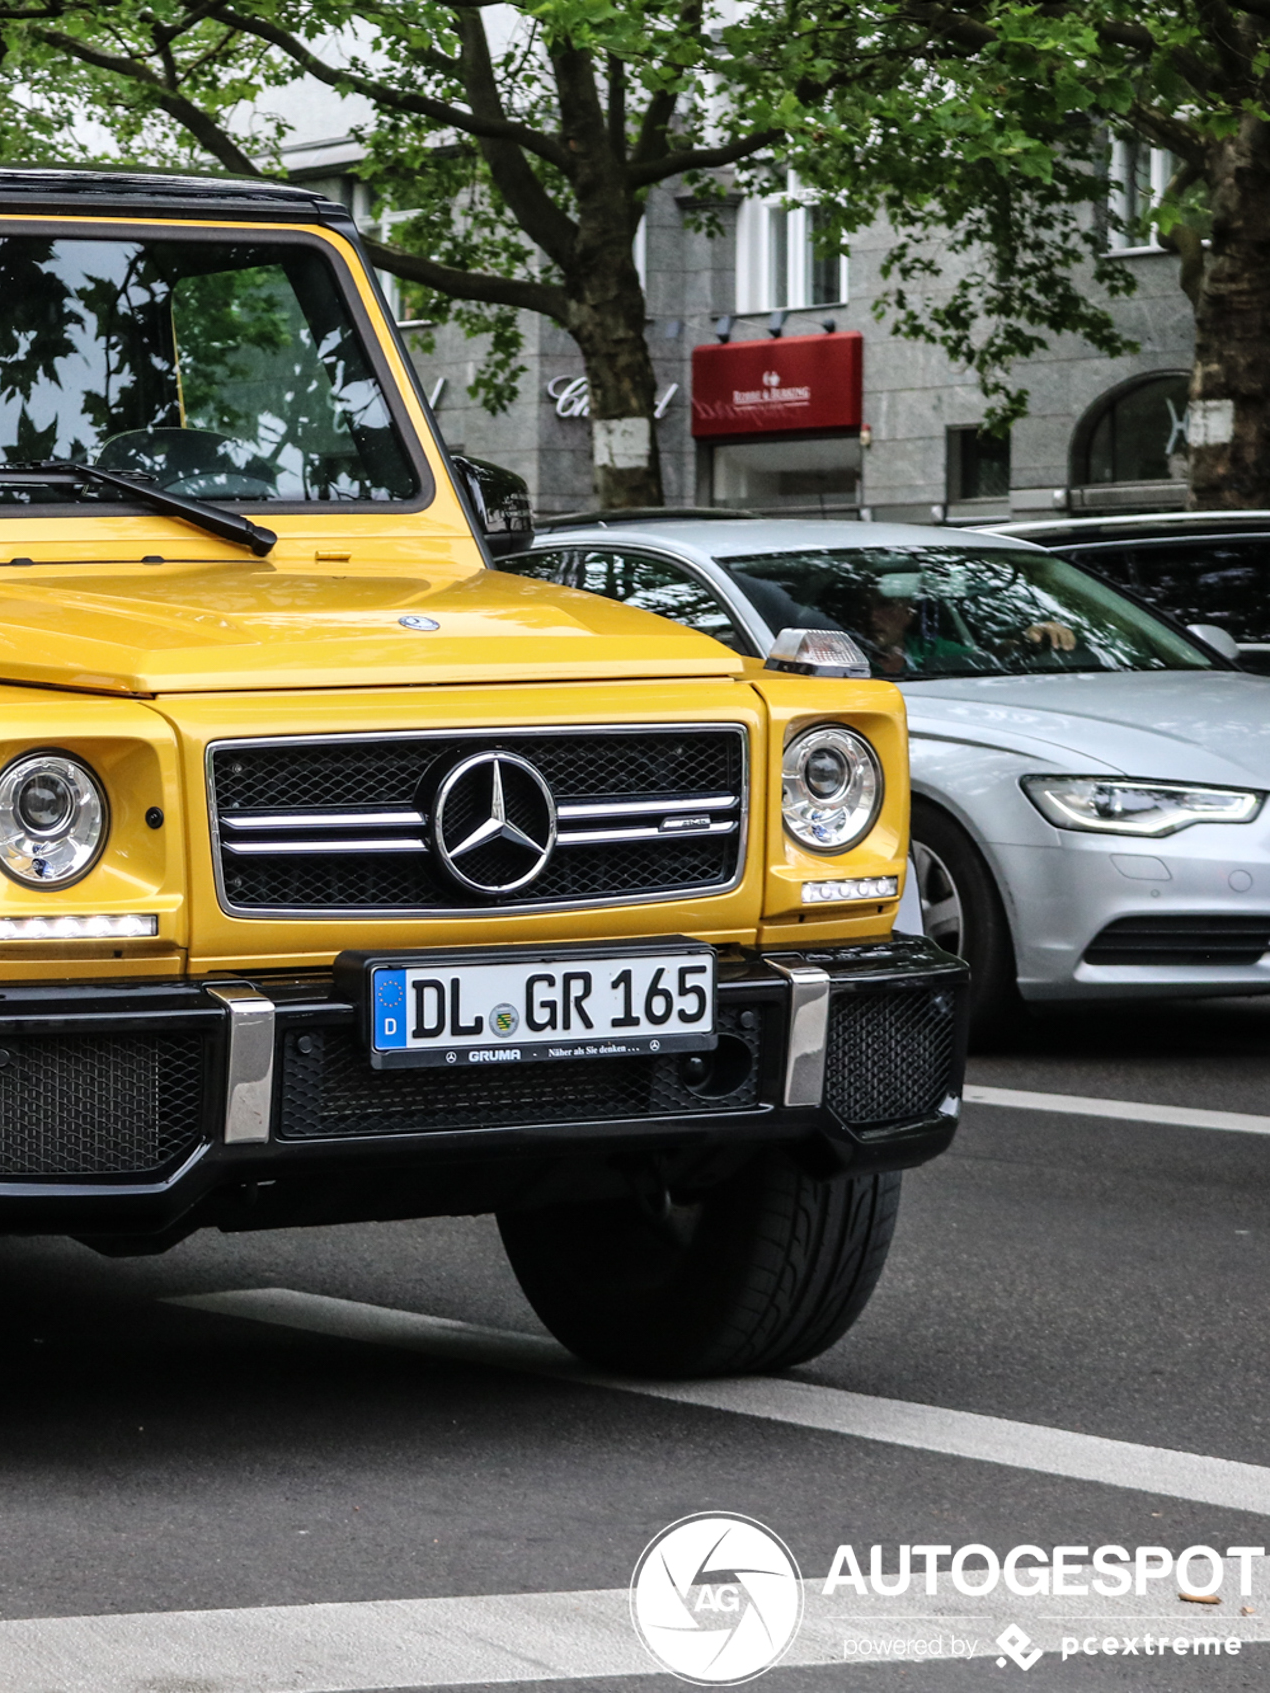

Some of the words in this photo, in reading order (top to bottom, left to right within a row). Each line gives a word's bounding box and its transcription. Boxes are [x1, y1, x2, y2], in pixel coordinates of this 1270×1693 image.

[411, 977, 484, 1039] DL
[525, 971, 594, 1032] GR
[610, 965, 708, 1028] 165
[384, 1017, 397, 1035] D
[468, 1049, 521, 1063] GRUMA
[548, 1048, 572, 1057] Näher
[573, 1046, 585, 1055] als
[586, 1045, 598, 1055] Sie
